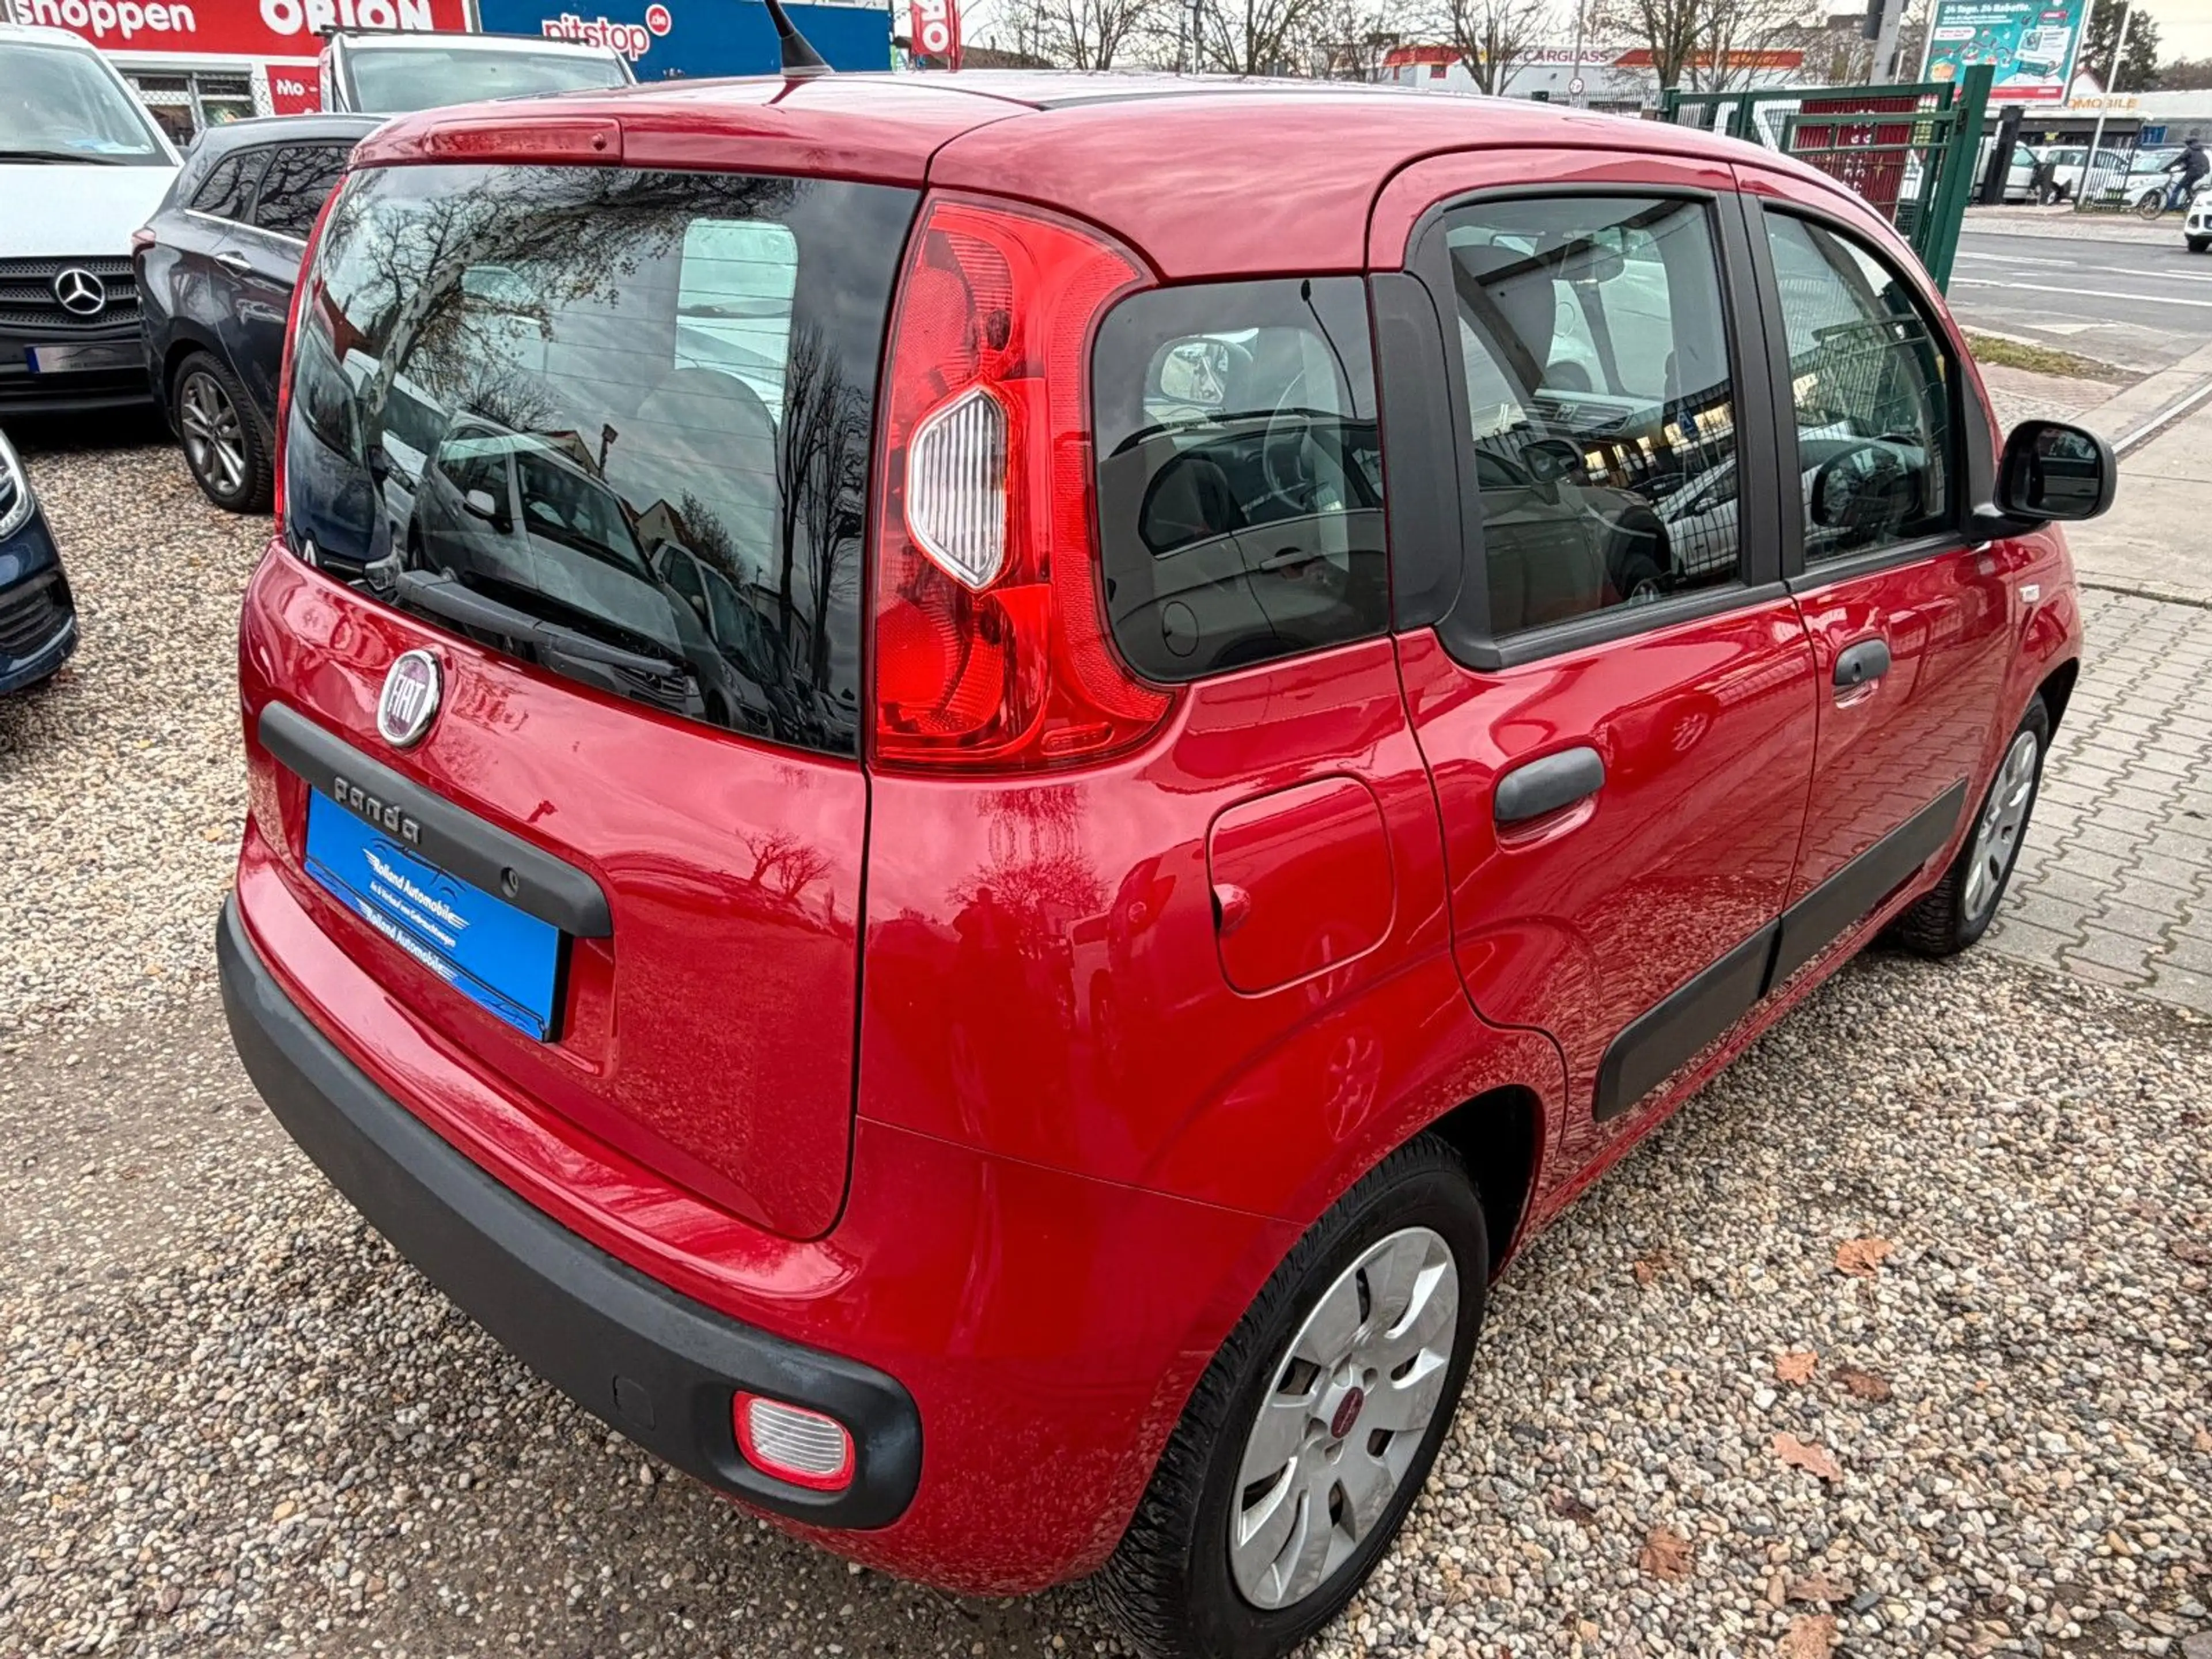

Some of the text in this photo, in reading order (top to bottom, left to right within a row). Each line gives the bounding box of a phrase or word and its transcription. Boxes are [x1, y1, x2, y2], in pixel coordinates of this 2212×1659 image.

[16, 0, 196, 39] shoppen
[260, 0, 433, 35] ORION
[1524, 50, 1609, 63] CARGLASS
[276, 79, 304, 96] Mo
[387, 673, 426, 723] FIAT
[334, 777, 419, 843] panda
